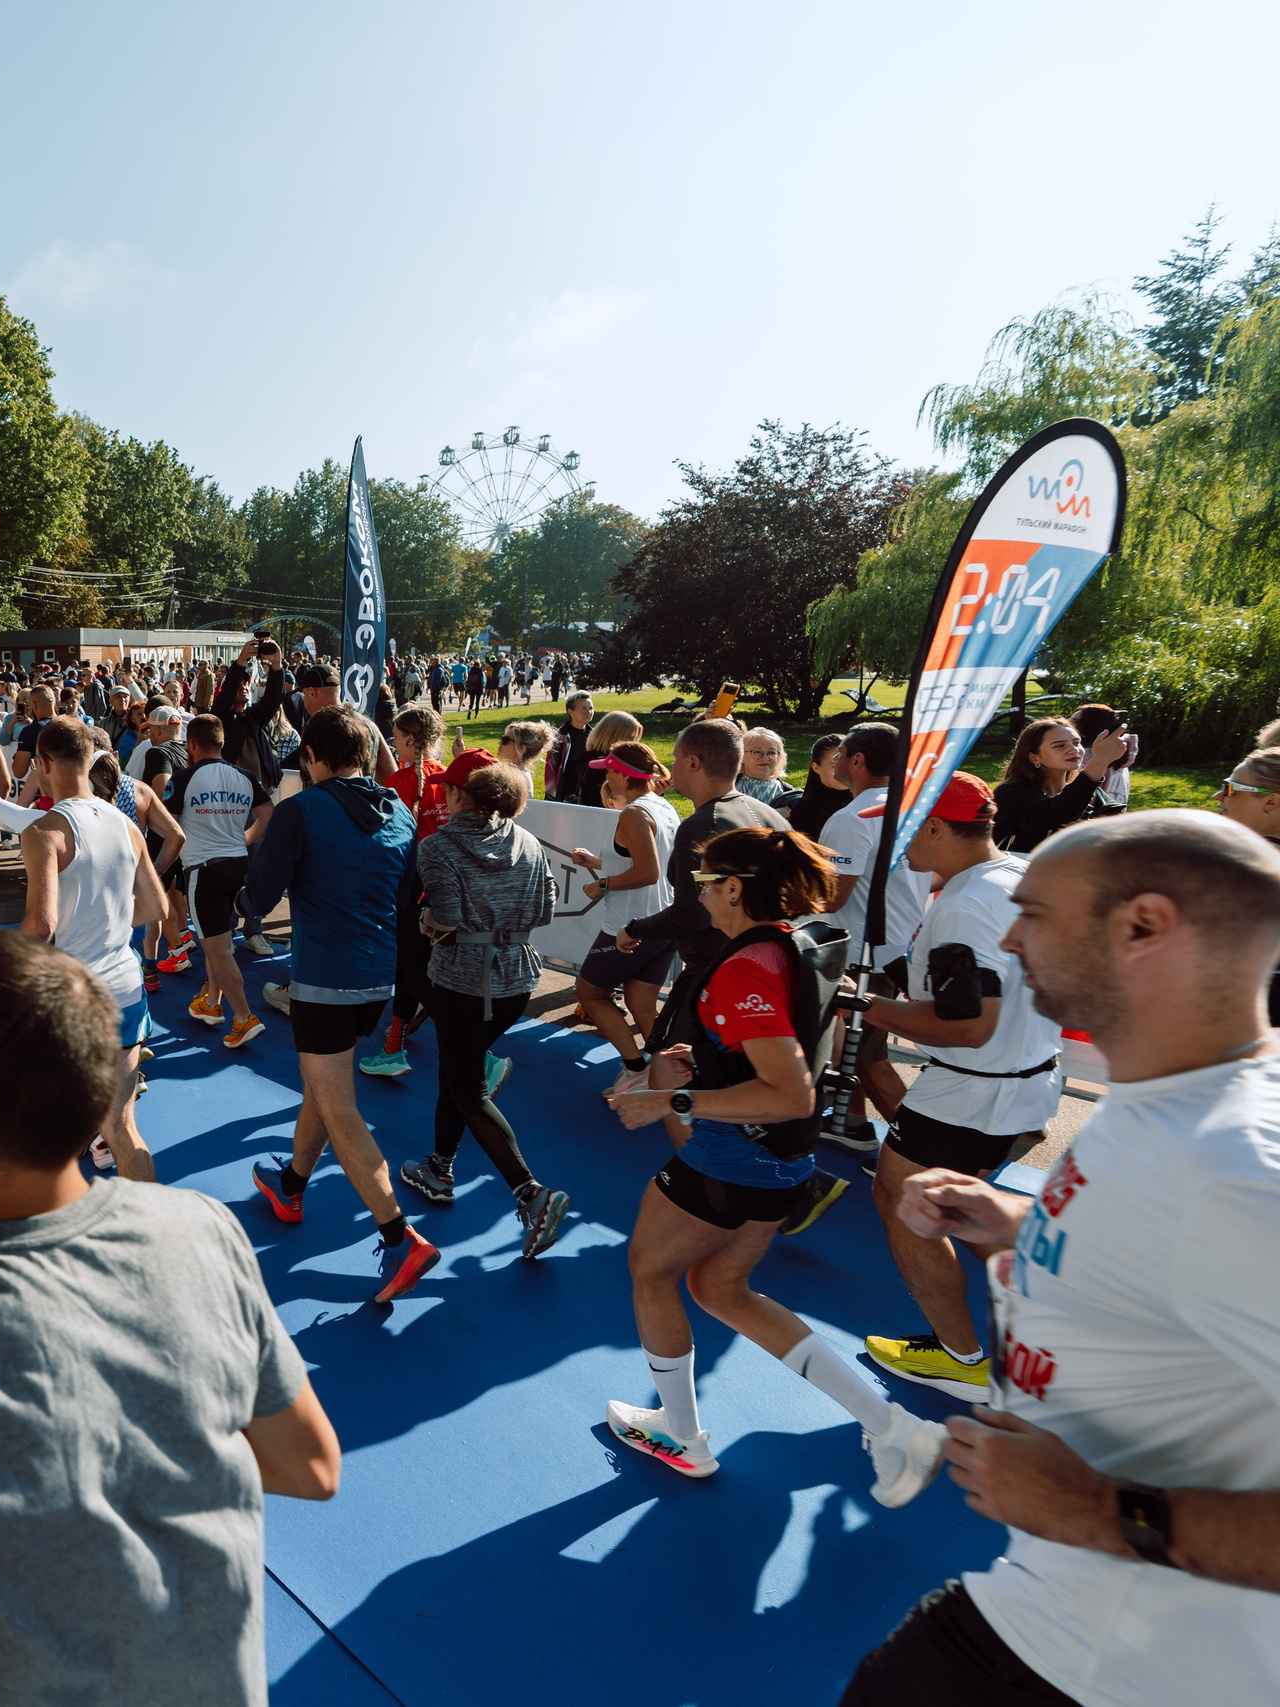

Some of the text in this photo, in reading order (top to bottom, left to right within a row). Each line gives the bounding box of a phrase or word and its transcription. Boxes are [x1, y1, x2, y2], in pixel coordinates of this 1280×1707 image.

[1016, 516, 1087, 535] ТУЛЬСКИЙ МАРАФОН
[351, 479, 376, 650] ЭВОКОМ
[950, 562, 1061, 636] 2:04
[190, 790, 252, 808] АРКТИКА
